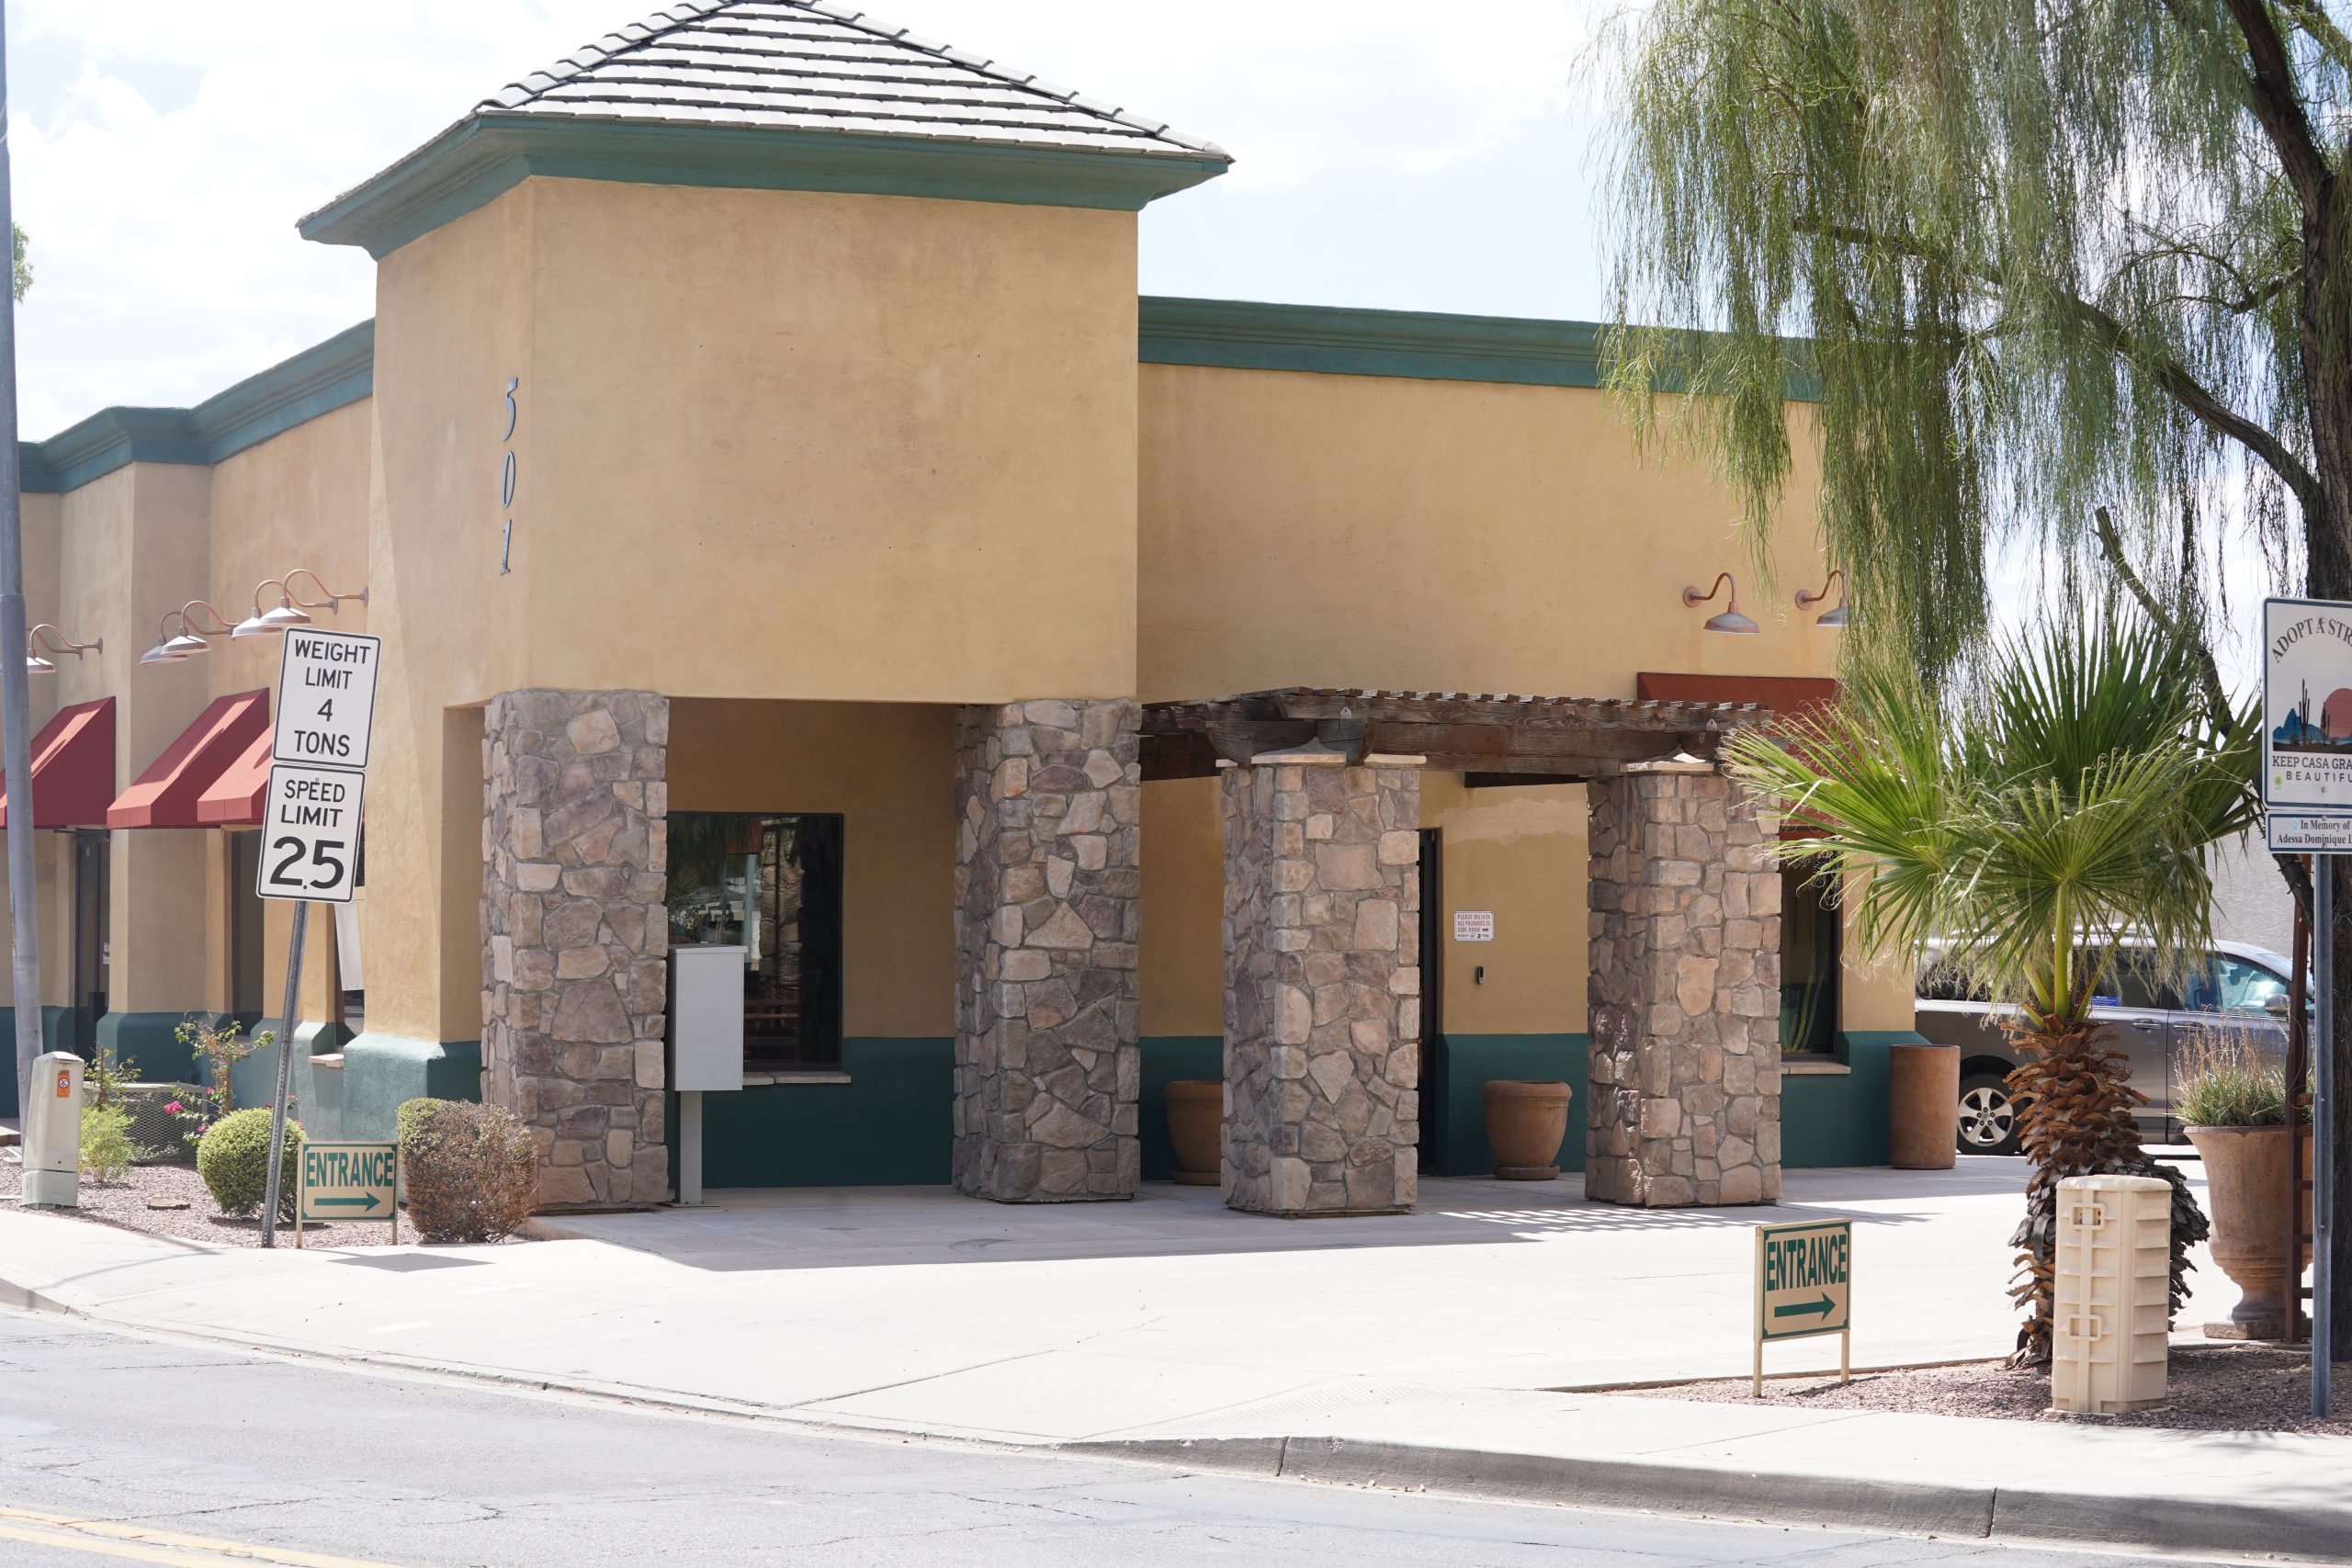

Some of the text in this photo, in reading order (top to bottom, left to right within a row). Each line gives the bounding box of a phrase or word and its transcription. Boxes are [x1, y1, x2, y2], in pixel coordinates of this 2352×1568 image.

[501, 377, 518, 576] 501
[295, 638, 371, 664] WEIGHT
[2271, 618, 2312, 664] ADOPT
[2316, 617, 2325, 634] A
[305, 666, 353, 690] LIMIT
[317, 698, 334, 722] 4
[294, 729, 350, 757] TONS
[2272, 755, 2300, 768] KEEP
[2301, 756, 2329, 769] CASA
[284, 779, 345, 803] SPEED
[280, 804, 344, 828] LIMIT
[2301, 819, 2351, 832] In Memory of
[2278, 833, 2302, 843] Adessa
[2304, 833, 2346, 846] Dominique
[269, 836, 345, 889] 25
[306, 1152, 394, 1187] ENTRANCE
[1767, 1234, 1847, 1292] ENTRANCE
